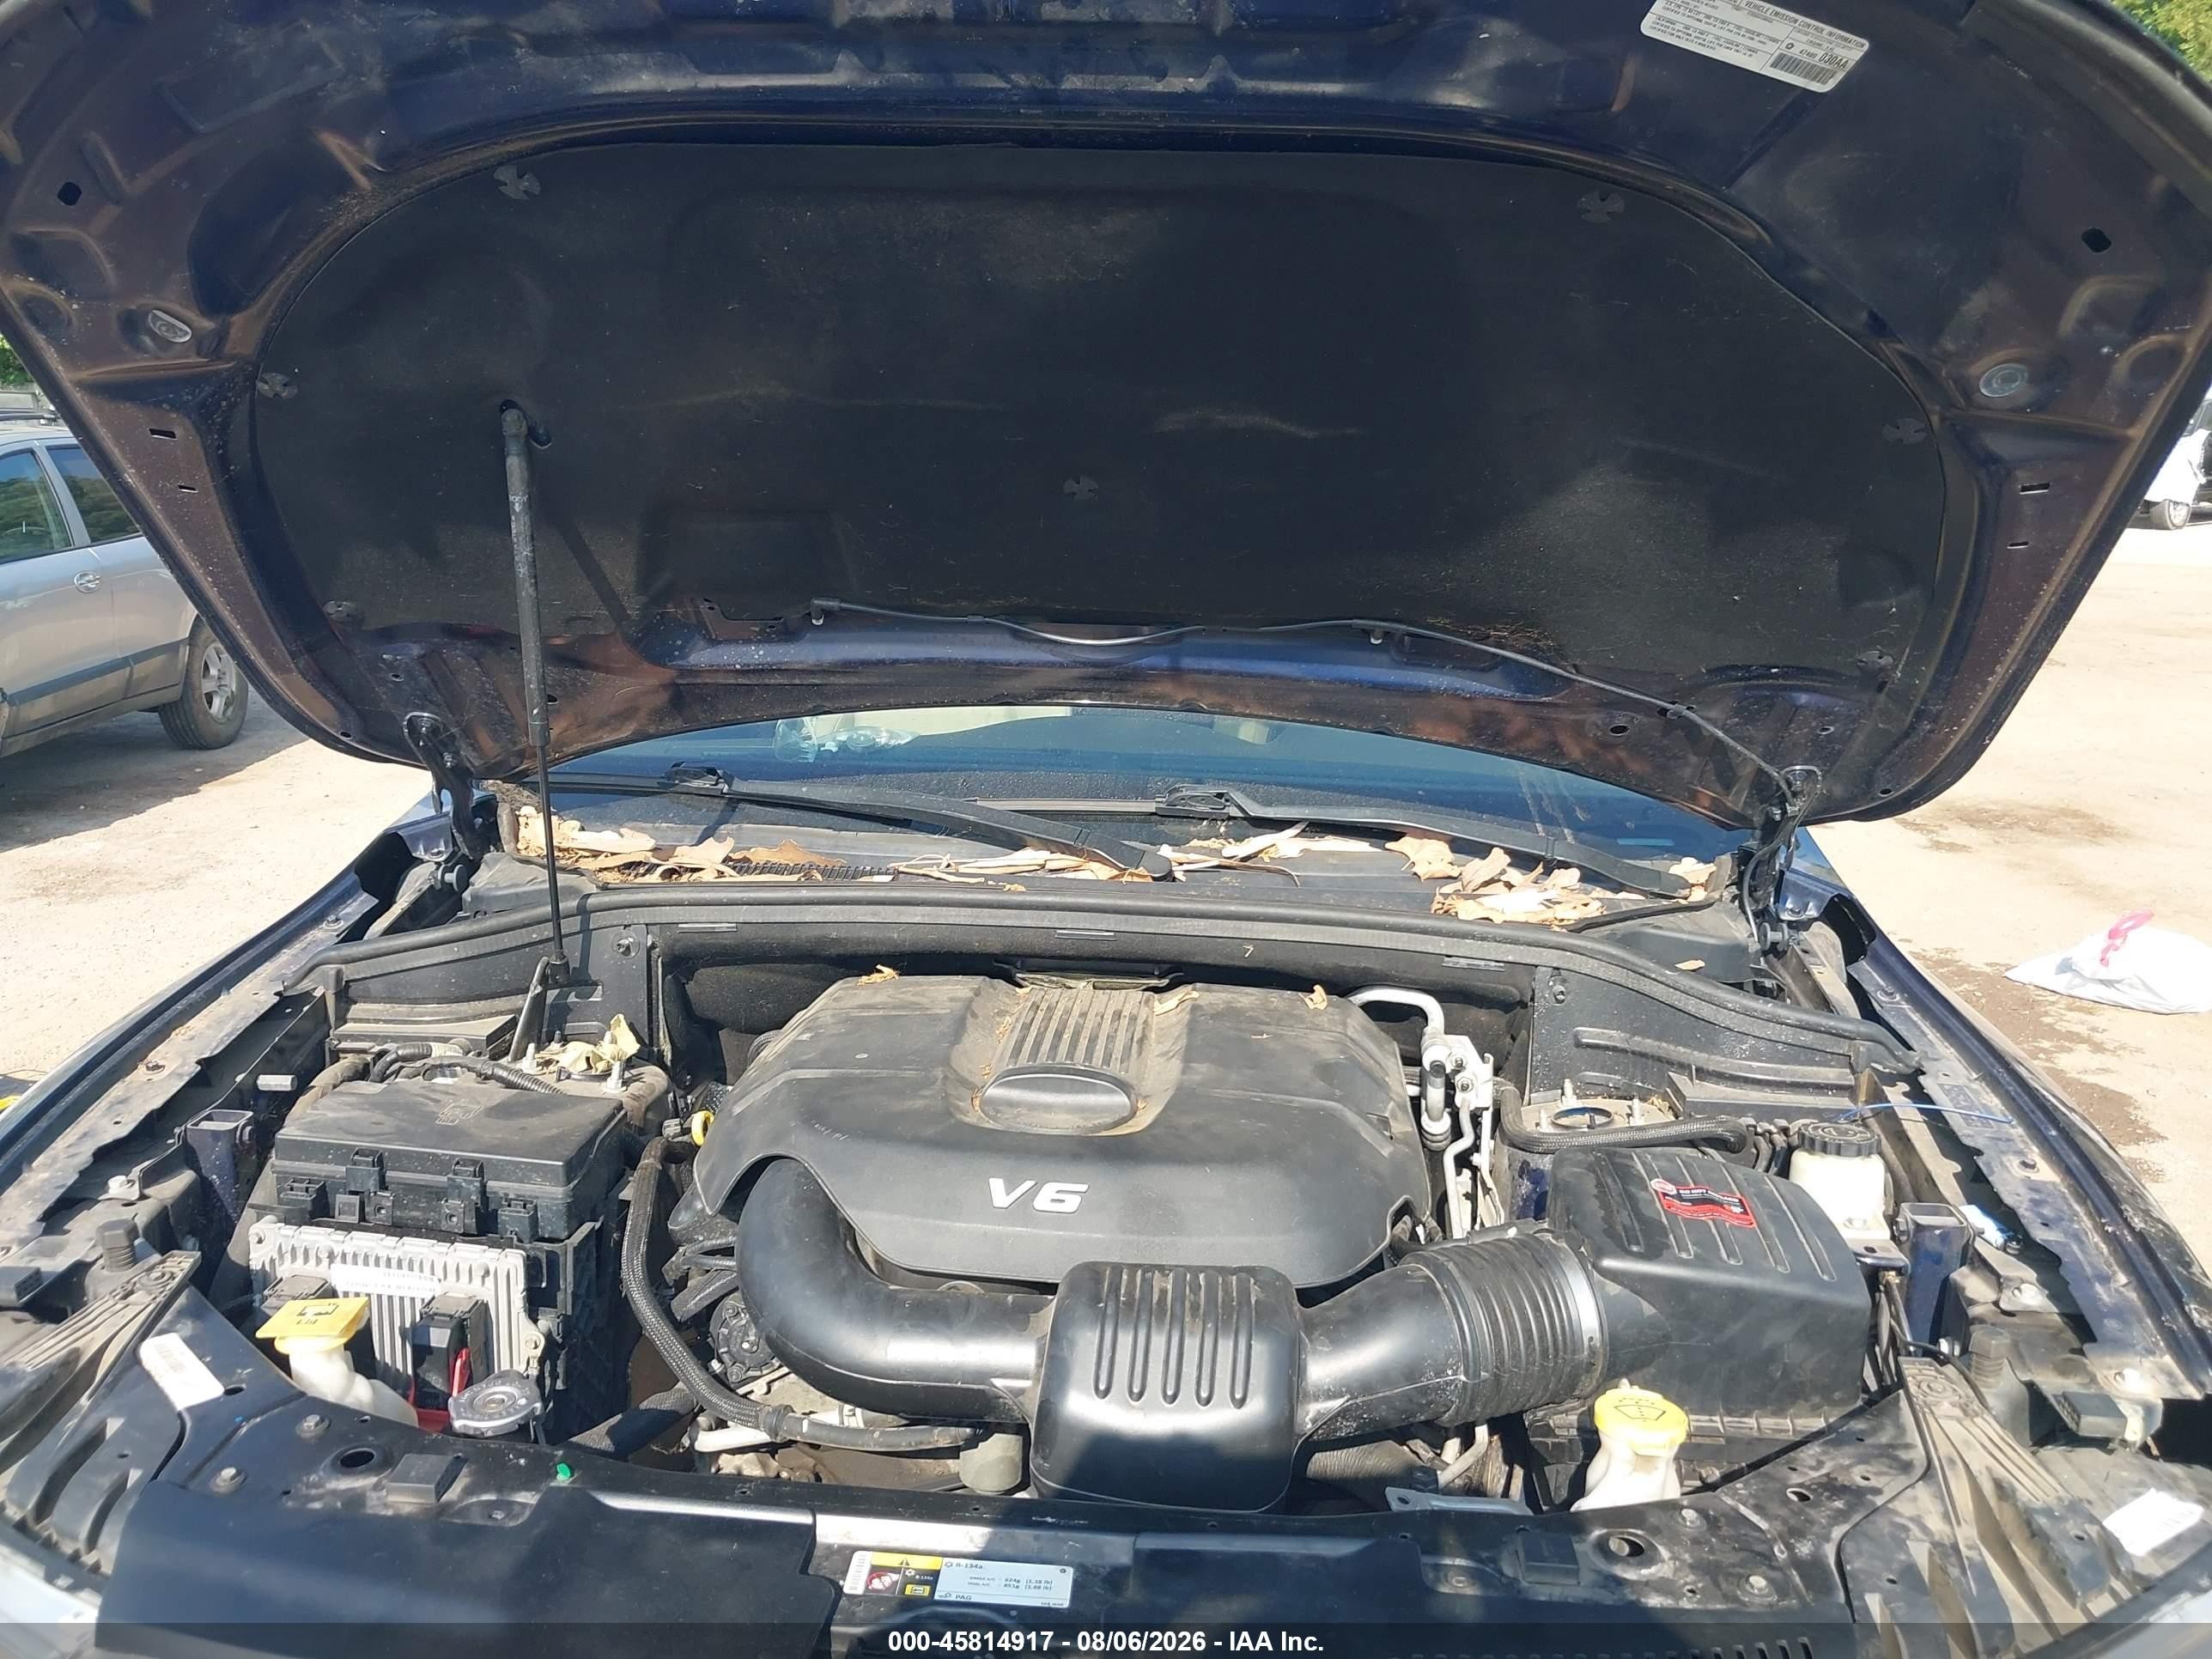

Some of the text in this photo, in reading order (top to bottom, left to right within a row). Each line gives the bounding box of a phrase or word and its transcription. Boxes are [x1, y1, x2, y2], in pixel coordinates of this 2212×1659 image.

[1745, 0, 1770, 15] VEHICLE
[1769, 9, 1799, 25] EMISSION
[1798, 20, 1826, 34] CONTROL
[1825, 30, 1867, 49] INFORMATION
[1819, 52, 1850, 70] 030AA
[988, 1176, 1091, 1214] V6
